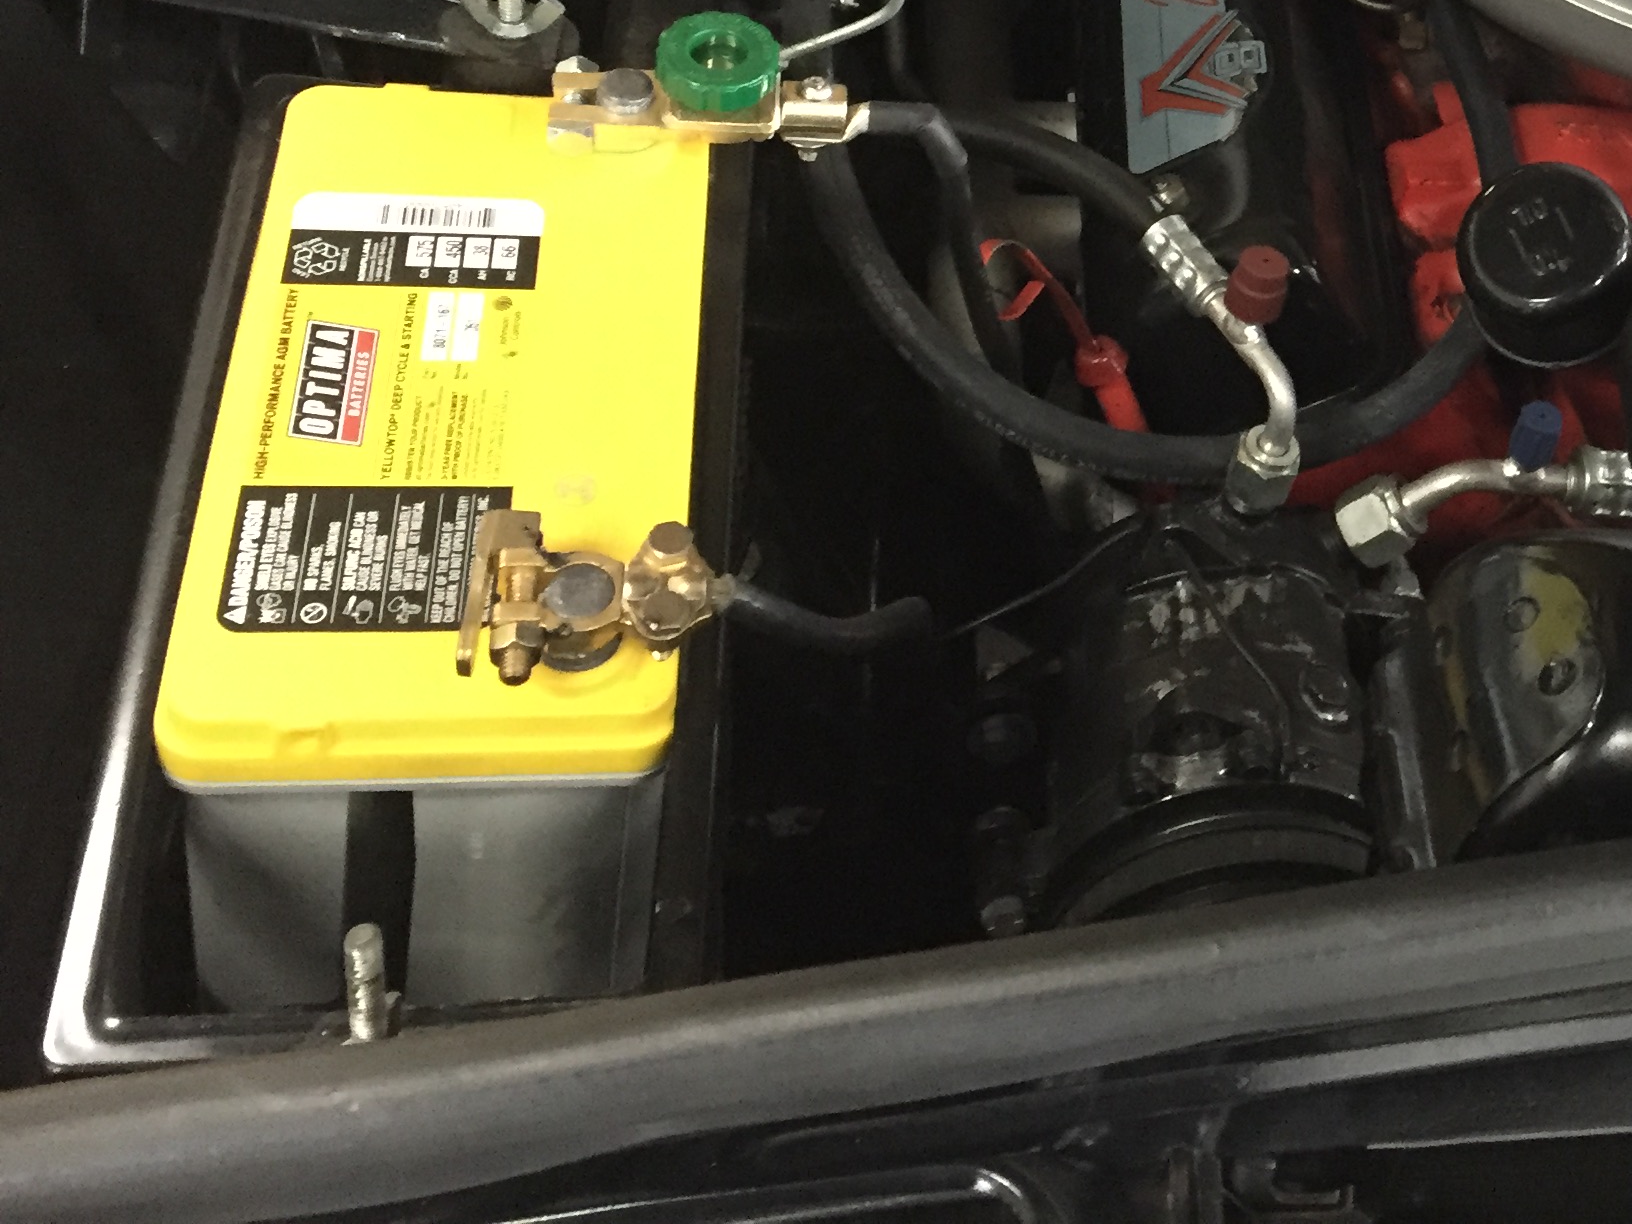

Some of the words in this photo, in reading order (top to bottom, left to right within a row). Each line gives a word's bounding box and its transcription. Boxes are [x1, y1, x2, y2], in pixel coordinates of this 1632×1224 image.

[416, 240, 434, 258] 575
[445, 240, 463, 258] 450
[473, 245, 490, 256] 38
[501, 245, 517, 258] 66
[419, 268, 430, 279] CA
[448, 269, 459, 284] CCA
[280, 288, 299, 335] BATTERY
[401, 292, 418, 341] STARTING
[275, 337, 291, 361] AGM
[395, 351, 410, 383] CYCLE
[298, 330, 351, 436] OPTIMA
[347, 351, 371, 417] BATTERIES
[390, 384, 404, 411] DEEP
[253, 363, 286, 480] HIGH-PERFORMANCE
[280, 492, 298, 529] BLINDNESS
[352, 511, 367, 528] CAN
[366, 511, 379, 523] OR
[276, 530, 292, 552] CAUSE
[324, 521, 342, 557] SMOKING
[348, 528, 364, 549] ACID
[360, 523, 378, 565] BLINDNESS
[408, 531, 421, 545] GET
[438, 532, 453, 558] REACH
[452, 531, 466, 552] OPEN
[228, 500, 266, 607] DANGER/POISON
[258, 543, 277, 563] EYES
[273, 553, 288, 567] CAN
[392, 550, 406, 568] EYES
[449, 553, 464, 569] NOT
[341, 549, 361, 591] SULFURIC
[436, 558, 450, 574] THE
[254, 564, 273, 591] SHIELD
[303, 578, 318, 591] NO
[355, 566, 371, 591] CAUSE
[414, 573, 428, 591] HELP
[432, 587, 446, 603] OUT
[430, 604, 443, 624] KEEP
